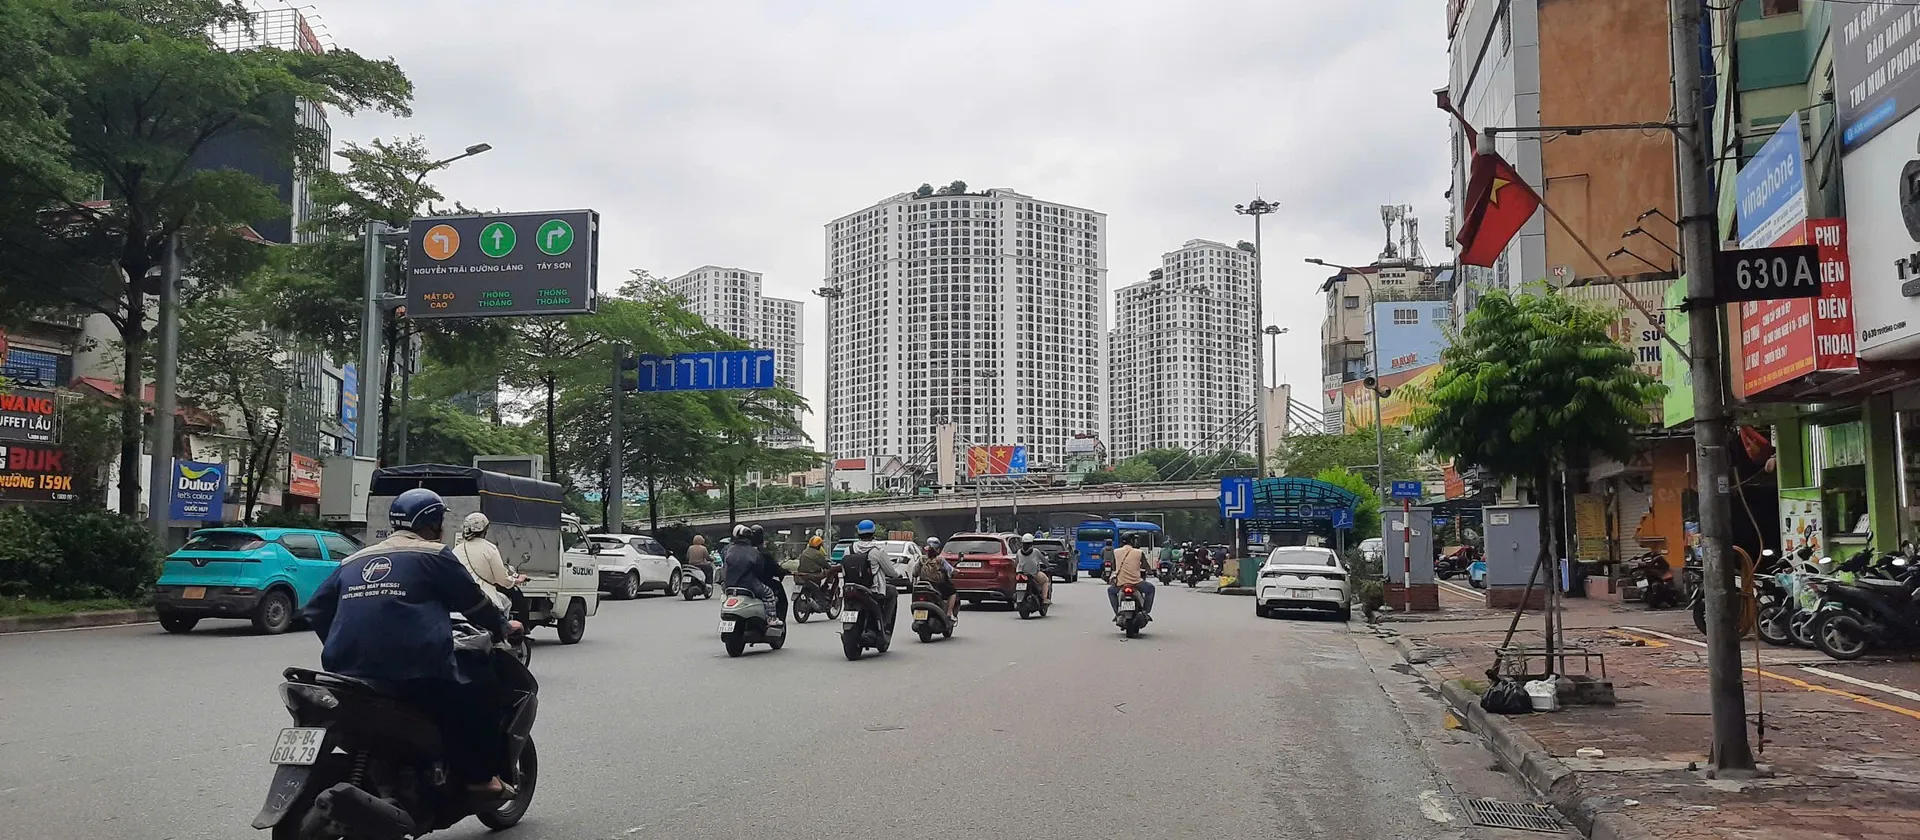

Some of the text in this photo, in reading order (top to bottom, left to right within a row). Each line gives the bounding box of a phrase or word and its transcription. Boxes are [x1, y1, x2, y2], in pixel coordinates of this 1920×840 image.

[1866, 33, 1884, 64] BẢO
[1885, 10, 1911, 49] HÀNH
[1849, 79, 1866, 109] THU
[1867, 65, 1886, 97] MUA
[1741, 153, 1794, 219] vinaphone
[1815, 225, 1840, 250] PHỤ
[413, 264, 468, 275] NGUYỄN TRÃI
[469, 263, 524, 273] ĐƯỜNG LÁNG
[536, 261, 572, 270] TÂY SƠN
[482, 290, 510, 298] THÔNG
[538, 288, 568, 297] THÔNG
[430, 301, 448, 309] CAO
[478, 299, 513, 308] THOÁNG
[535, 296, 571, 306] THOÁNG
[1818, 293, 1847, 324] ĐIỆN
[1817, 333, 1852, 359] THOẠI
[39, 474, 72, 491] 159K
[179, 476, 215, 492] Dulux
[177, 491, 214, 500] let's colour
[572, 567, 594, 576] SUZUKI
[283, 731, 318, 746] 36-B4
[273, 747, 316, 762] 604.79
